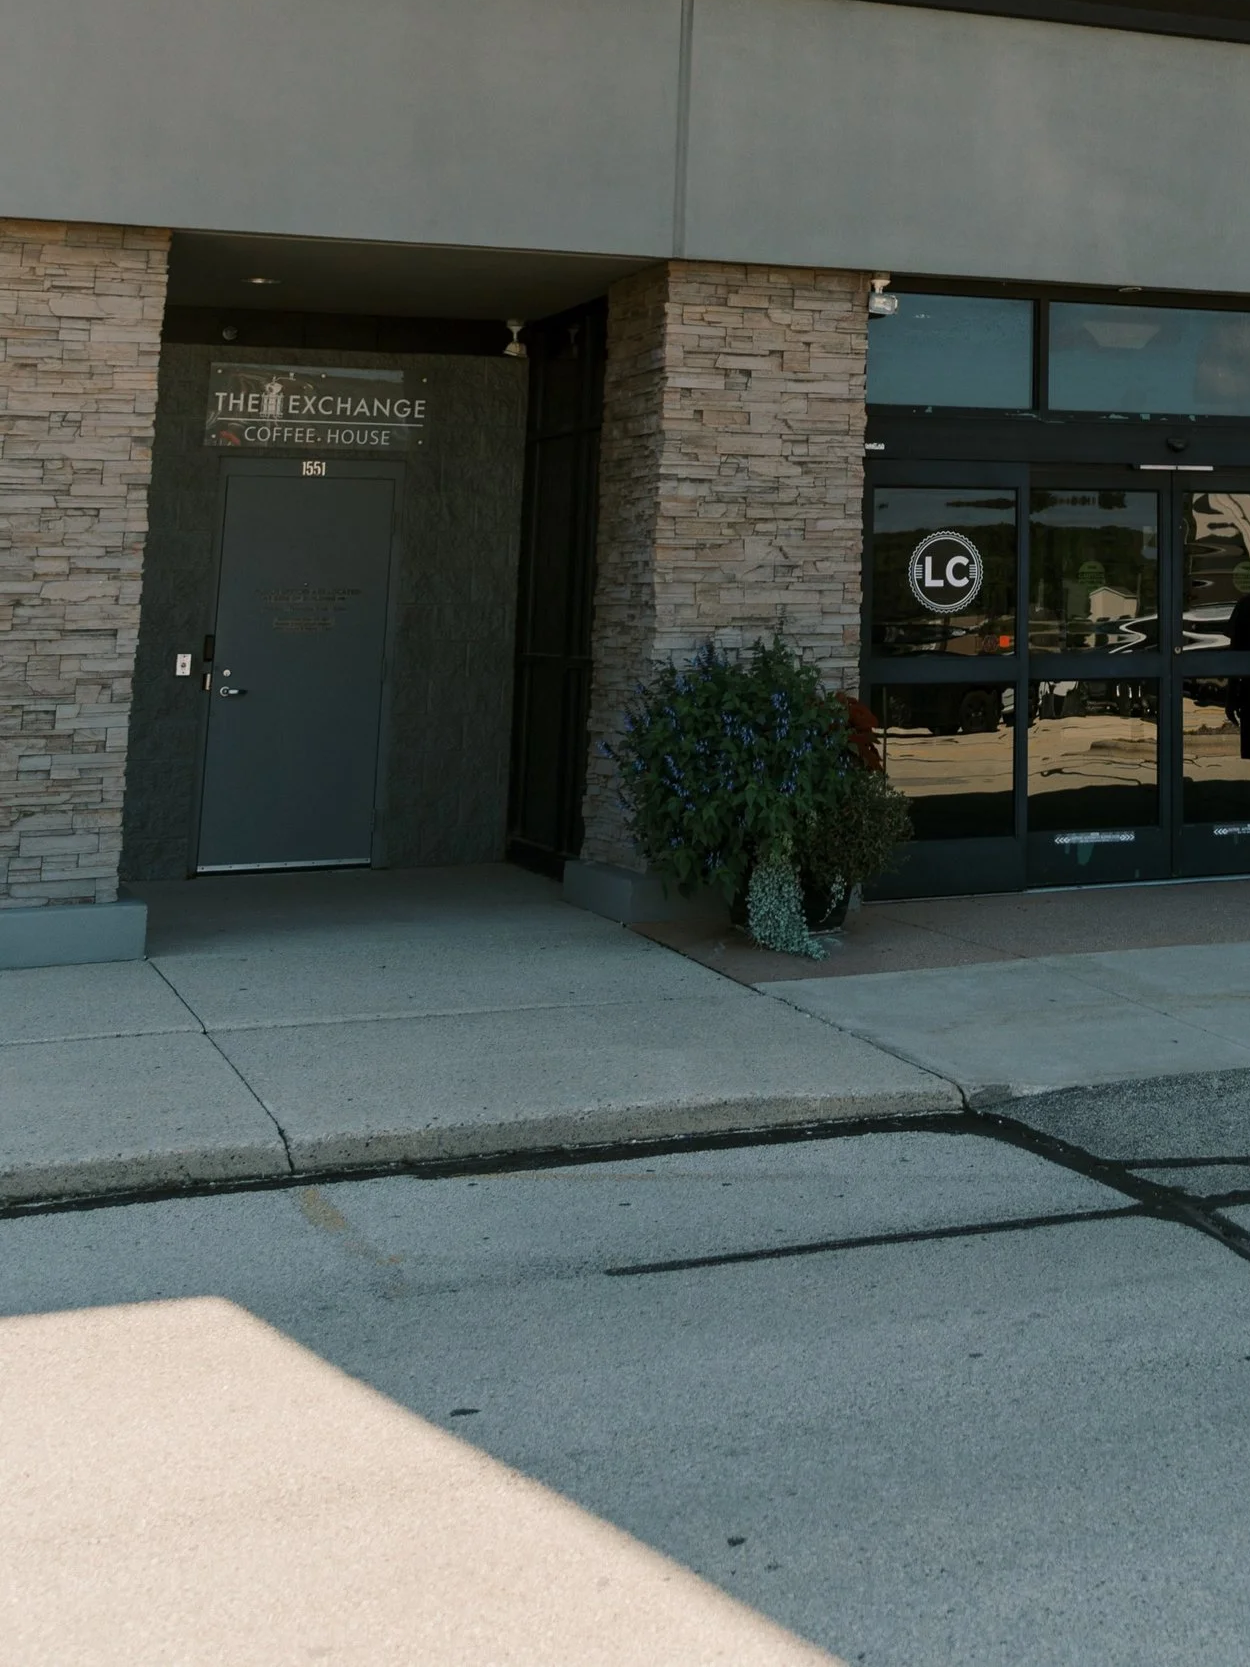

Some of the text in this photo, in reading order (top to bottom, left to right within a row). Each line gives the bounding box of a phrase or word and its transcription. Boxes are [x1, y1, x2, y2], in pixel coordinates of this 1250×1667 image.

[215, 391, 427, 419] THE EXCHANGE
[244, 425, 391, 446] COFFEE HOUSE
[302, 460, 326, 476] 1551
[924, 555, 970, 588] LC
